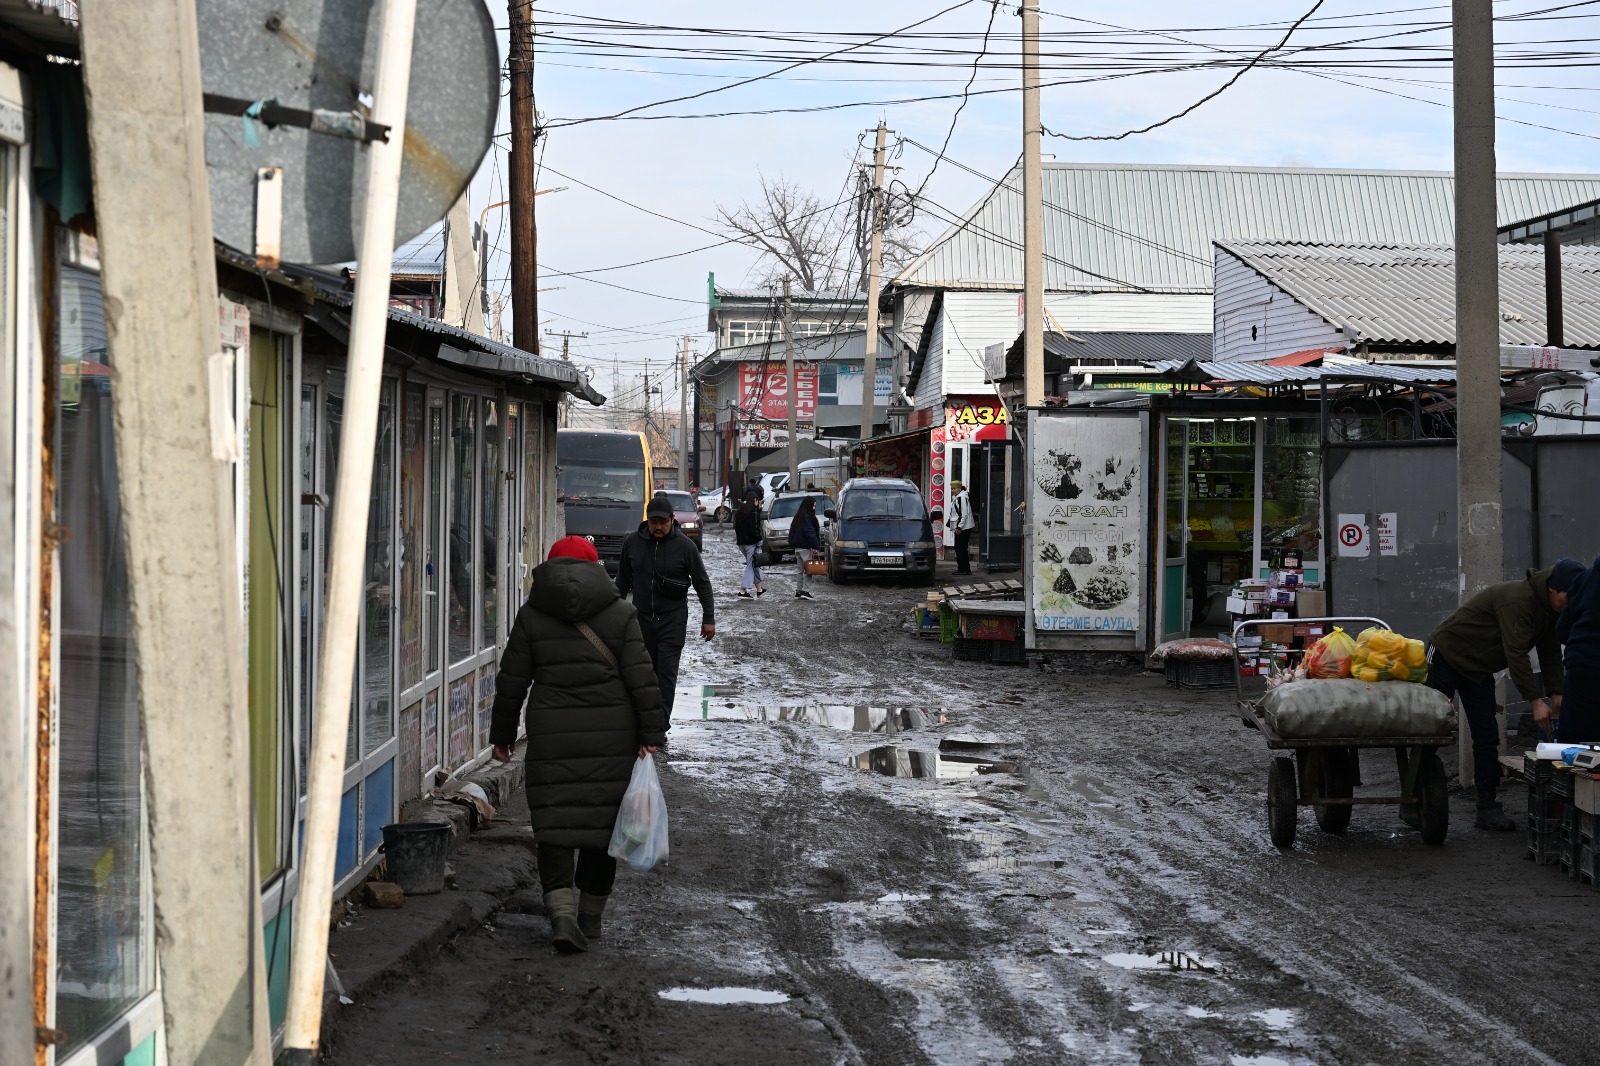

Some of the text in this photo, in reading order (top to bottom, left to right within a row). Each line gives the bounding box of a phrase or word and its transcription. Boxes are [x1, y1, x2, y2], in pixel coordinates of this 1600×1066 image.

[794, 362, 816, 417] МЕБЕЛЬ
[768, 399, 788, 407] ЭТАЖ
[1048, 504, 1128, 518] АРЗАН
[1052, 529, 1124, 542] ОПТОМ
[1094, 615, 1134, 630] САУДА
